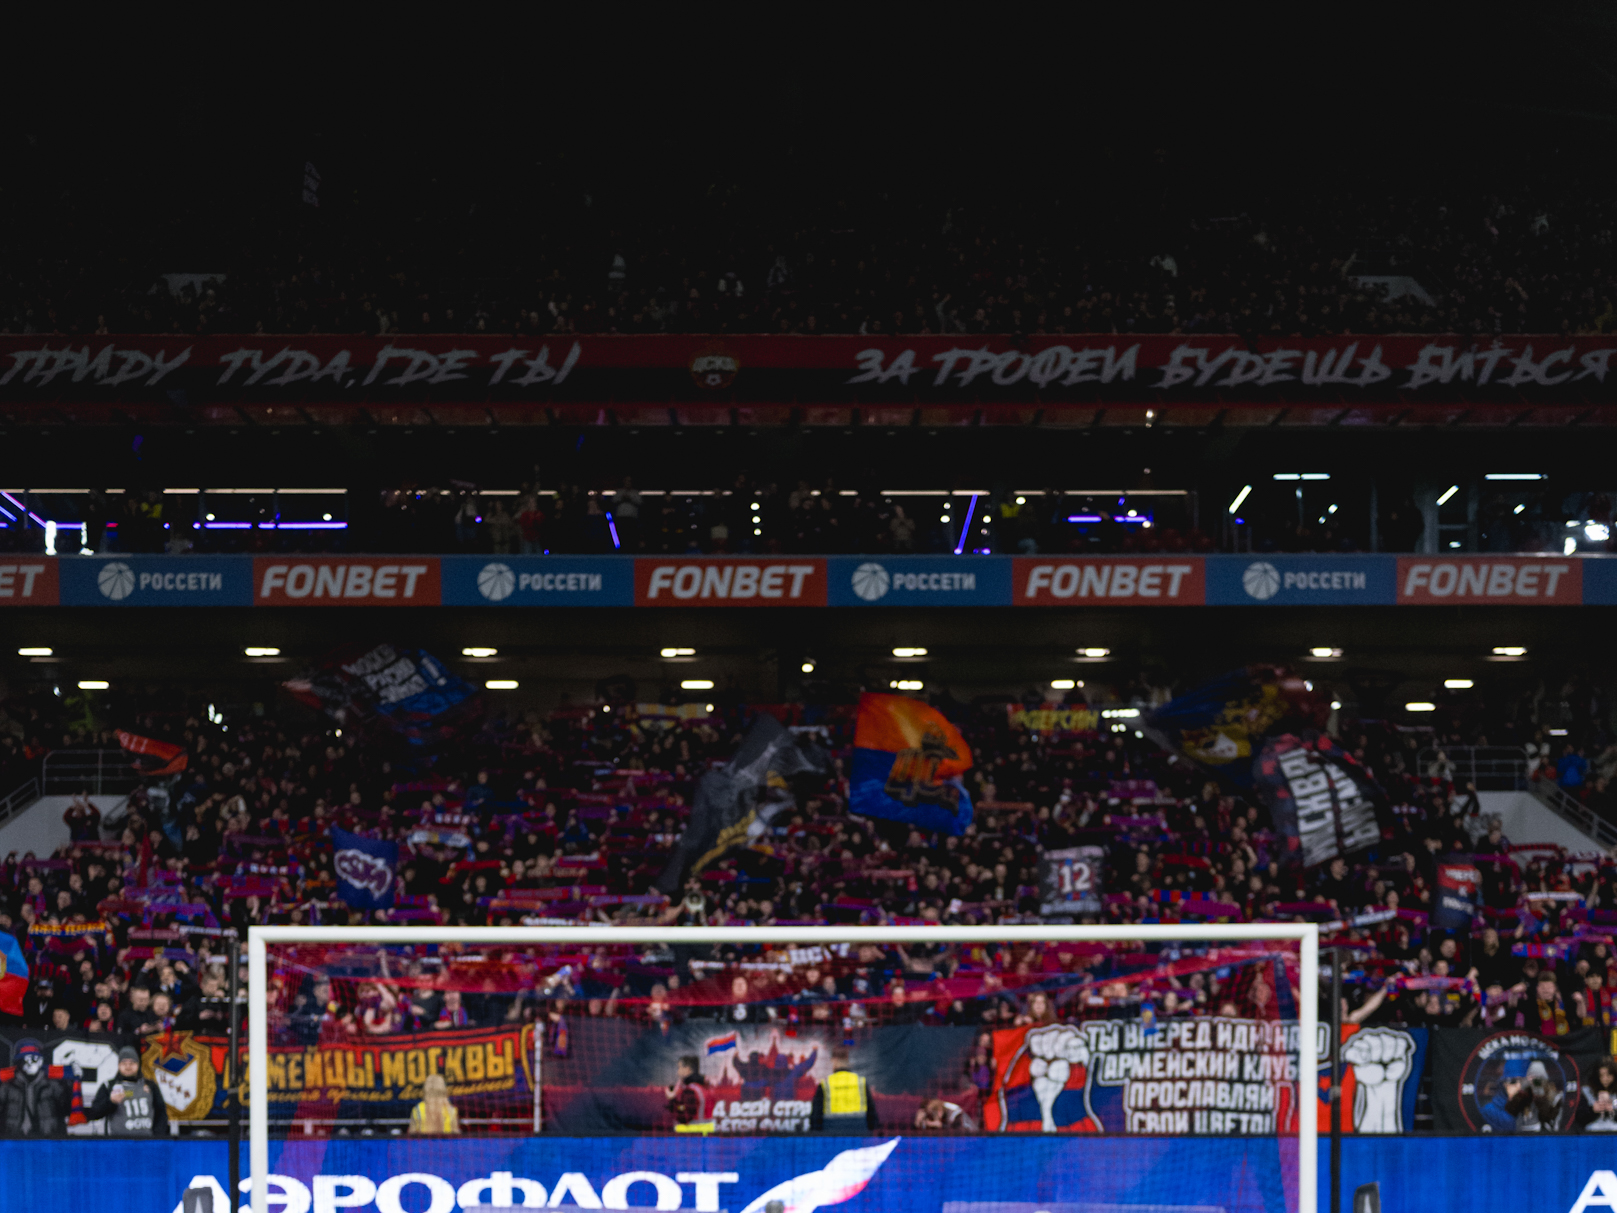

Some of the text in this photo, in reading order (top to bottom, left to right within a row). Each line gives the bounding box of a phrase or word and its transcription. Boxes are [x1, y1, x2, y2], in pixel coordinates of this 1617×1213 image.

[487, 341, 582, 387] ТЫ
[843, 348, 923, 386] ЗА
[1147, 341, 1393, 388] БУДЕШЬ
[140, 572, 222, 591] РОССЕТИ
[260, 565, 427, 598] FONBET
[519, 572, 602, 591] РОССЕТИ
[647, 565, 814, 599] FONBET
[893, 572, 976, 591] РОССЕТИ
[1025, 564, 1192, 598] FONBET
[1284, 571, 1366, 589] РОССЕТИ
[1404, 563, 1569, 597] FONBET
[1060, 862, 1091, 894] 12
[1087, 1026, 1119, 1051] ТЫ
[381, 1039, 514, 1087] МОСКВЫ
[1104, 1049, 1240, 1080] АРМЕЙСКИЙ
[124, 1097, 149, 1117] 115
[1129, 1080, 1274, 1109] ПРОСЛАВЛЯЙ
